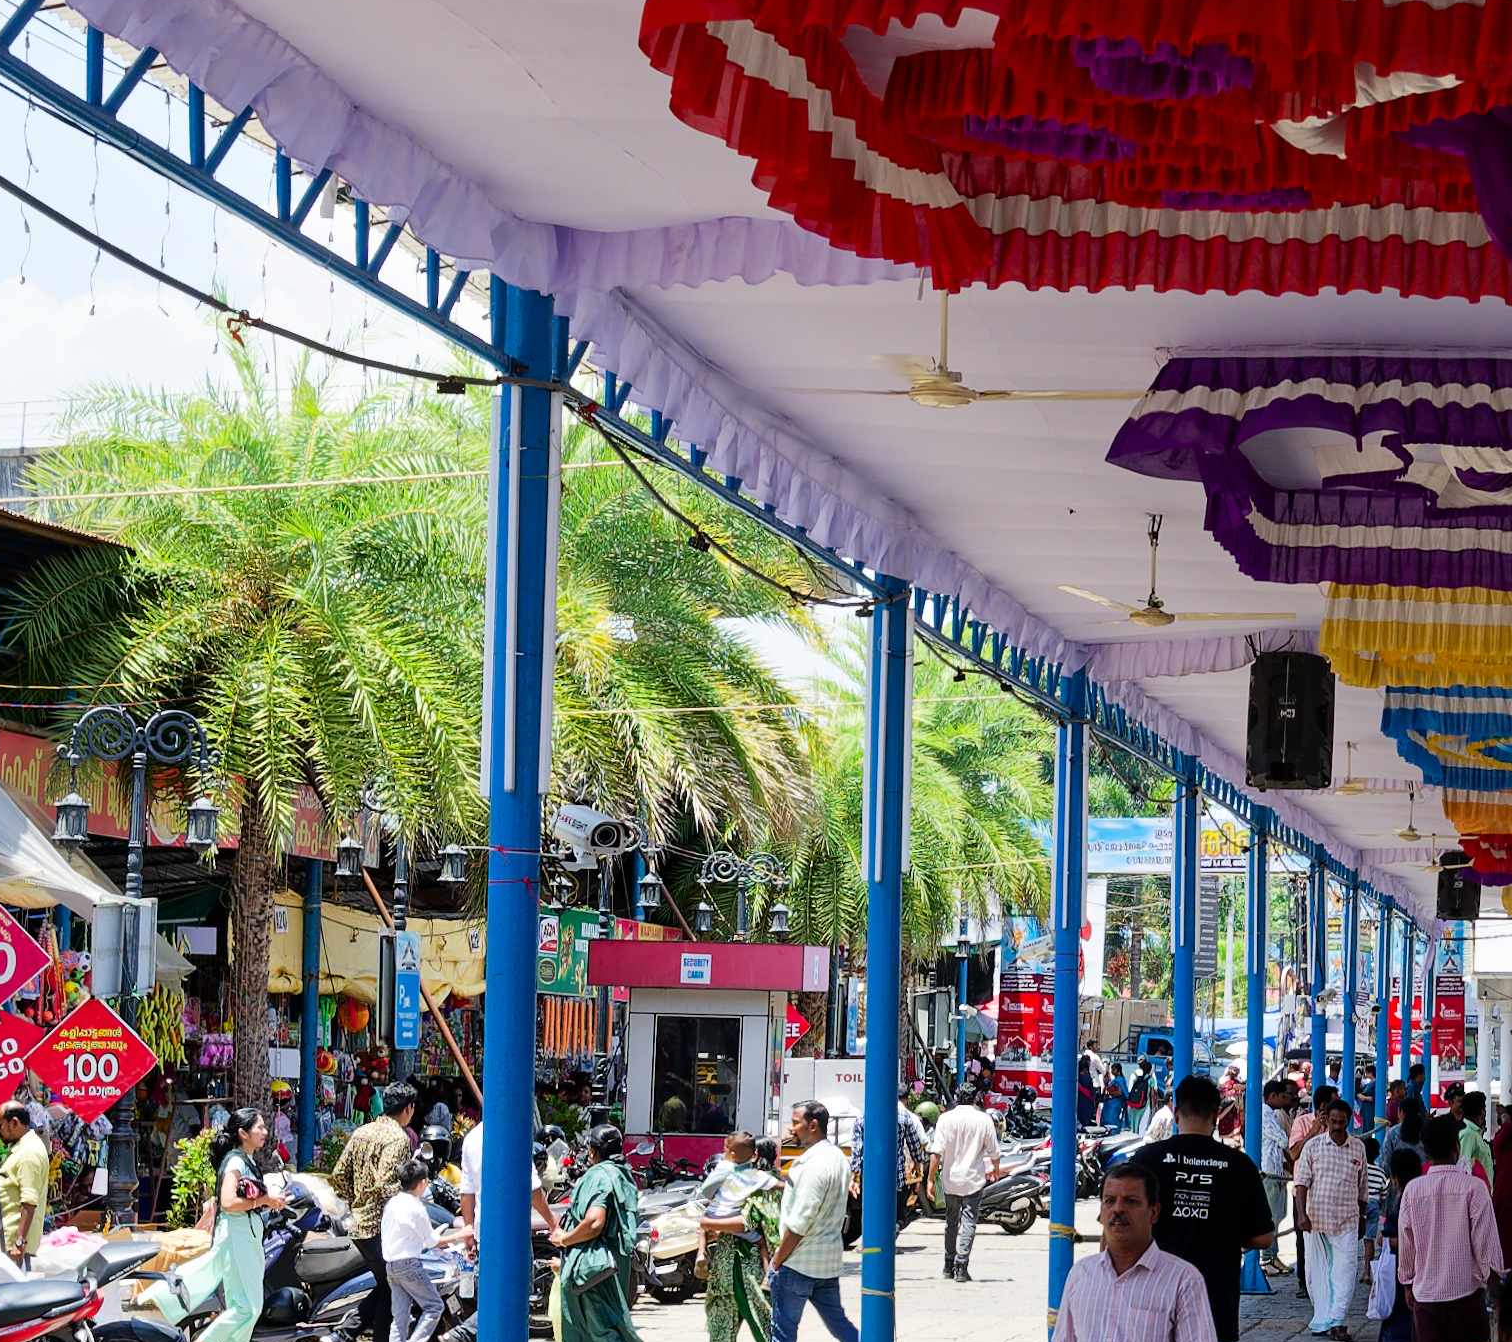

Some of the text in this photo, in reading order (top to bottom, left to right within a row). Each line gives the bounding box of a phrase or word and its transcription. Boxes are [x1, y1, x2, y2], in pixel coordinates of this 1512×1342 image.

[63, 1052, 120, 1083] 100
[835, 1073, 864, 1083] TOIL
[1176, 1171, 1213, 1184] PS5
